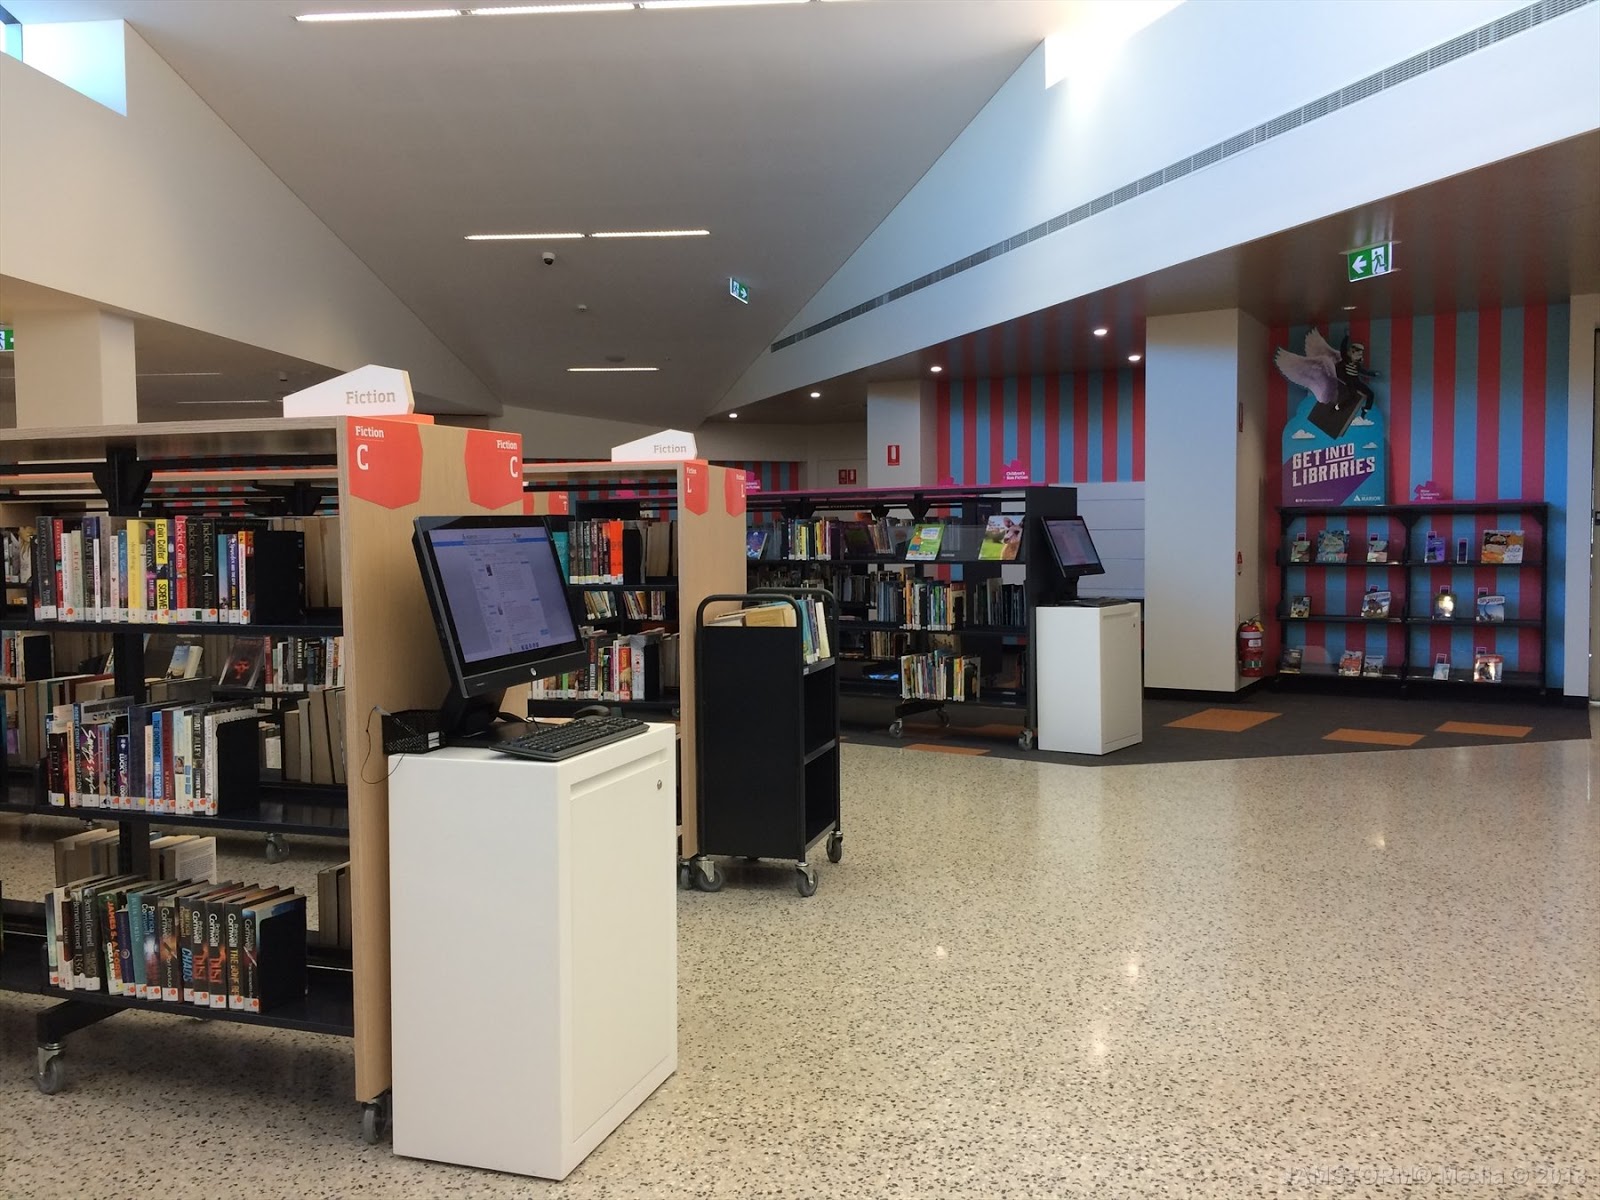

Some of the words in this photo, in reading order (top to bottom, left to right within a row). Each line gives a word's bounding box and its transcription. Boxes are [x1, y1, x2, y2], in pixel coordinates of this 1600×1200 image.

[345, 389, 396, 404] Fiction
[355, 425, 385, 438] Fiction
[496, 439, 518, 450] Fiction
[652, 443, 687, 454] Fiction
[1292, 449, 1322, 470] GET
[1325, 443, 1355, 460] INTO
[356, 444, 369, 471] C
[510, 456, 519, 478] C
[1292, 456, 1376, 487] LIBRARIES
[687, 477, 692, 493] L
[157, 524, 165, 538] Eoin
[176, 520, 185, 543] Jackie
[202, 522, 212, 545] Jackie
[158, 539, 166, 560] Colfer
[177, 544, 186, 568] Collins
[204, 546, 212, 570] Collins
[154, 776, 162, 797] COOPER
[107, 901, 116, 930] JAMES
[192, 911, 201, 944] Cornwell
[209, 914, 218, 947] Cornwell
[228, 913, 237, 947] Cornwell
[244, 919, 253, 951] Cornwell
[182, 947, 193, 982] CHAOS
[193, 955, 206, 980] DUST
[230, 949, 238, 964] THE
[209, 959, 222, 984] DUST
